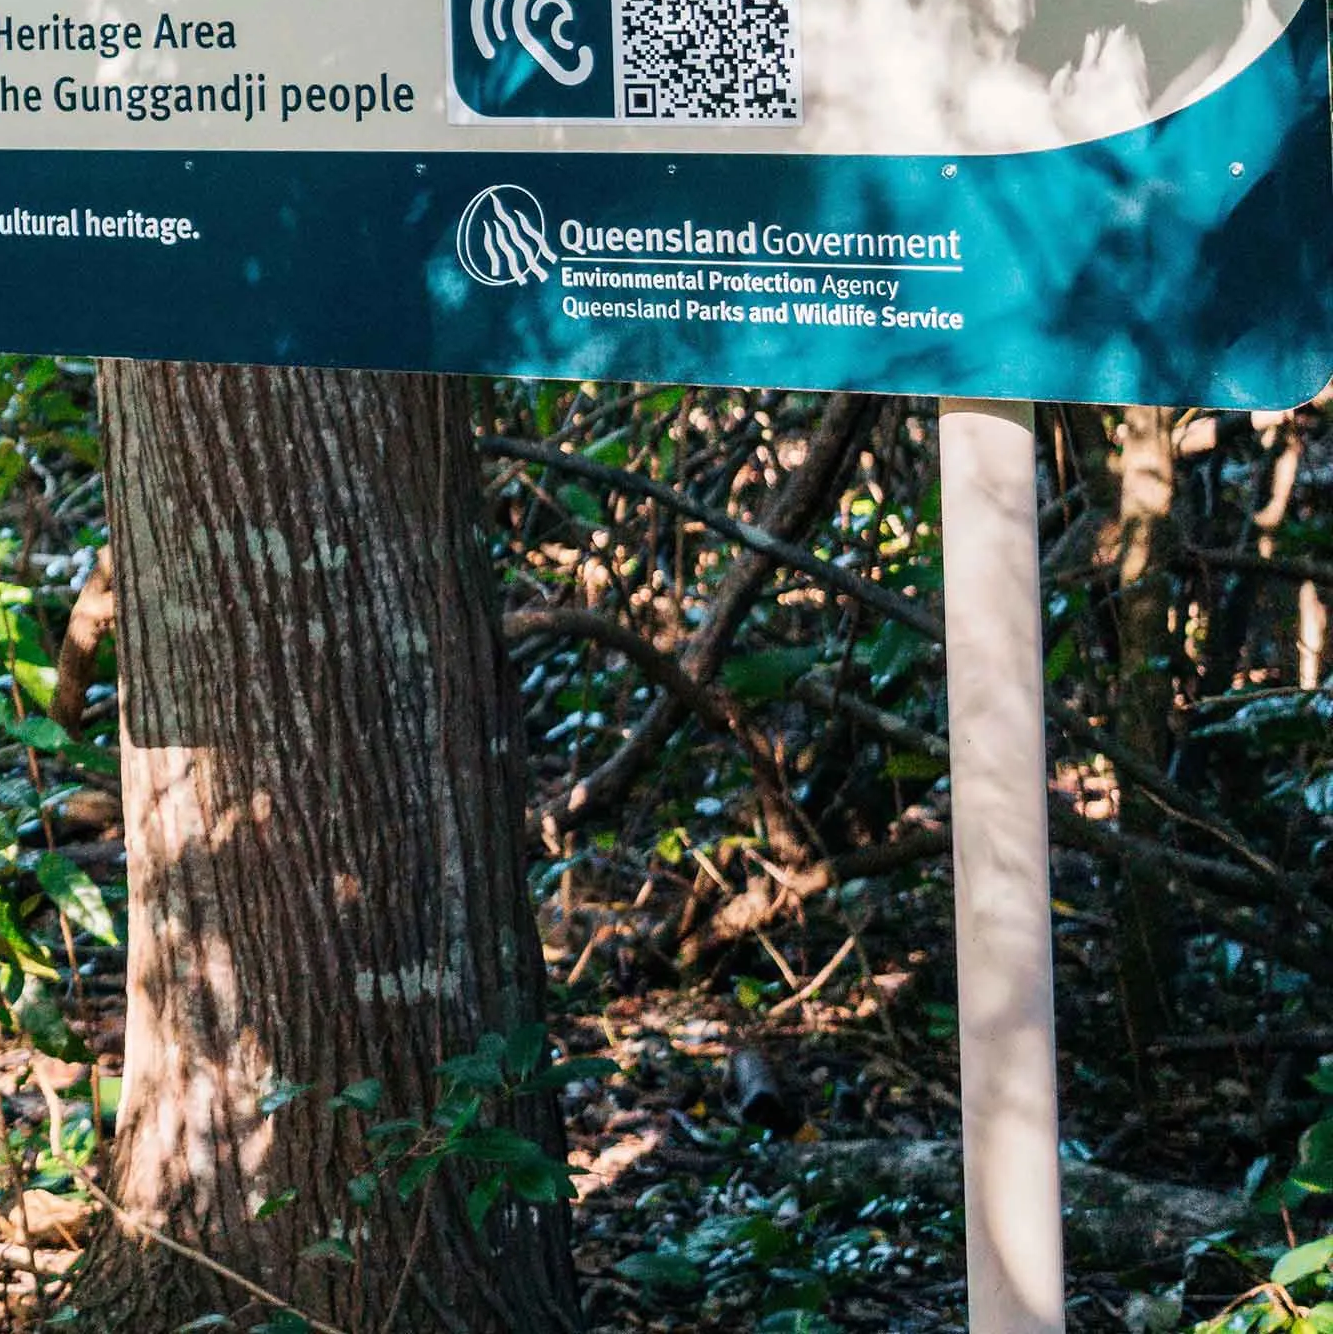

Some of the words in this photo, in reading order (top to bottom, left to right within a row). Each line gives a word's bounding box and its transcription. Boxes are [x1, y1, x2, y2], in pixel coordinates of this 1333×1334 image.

[153, 13, 237, 49] Area
[53, 73, 266, 123] Gunggandji
[281, 72, 414, 123] people
[85, 208, 200, 246] heritage.
[559, 219, 758, 256] Queensland
[762, 224, 962, 261] Government
[561, 266, 705, 291] Environmental
[708, 270, 817, 294] Protection
[821, 273, 900, 301] Agency
[562, 296, 681, 320] Queensland
[686, 299, 746, 323] Parks
[748, 301, 790, 324] and
[792, 302, 878, 327] Wildlife
[881, 305, 964, 331] Service
